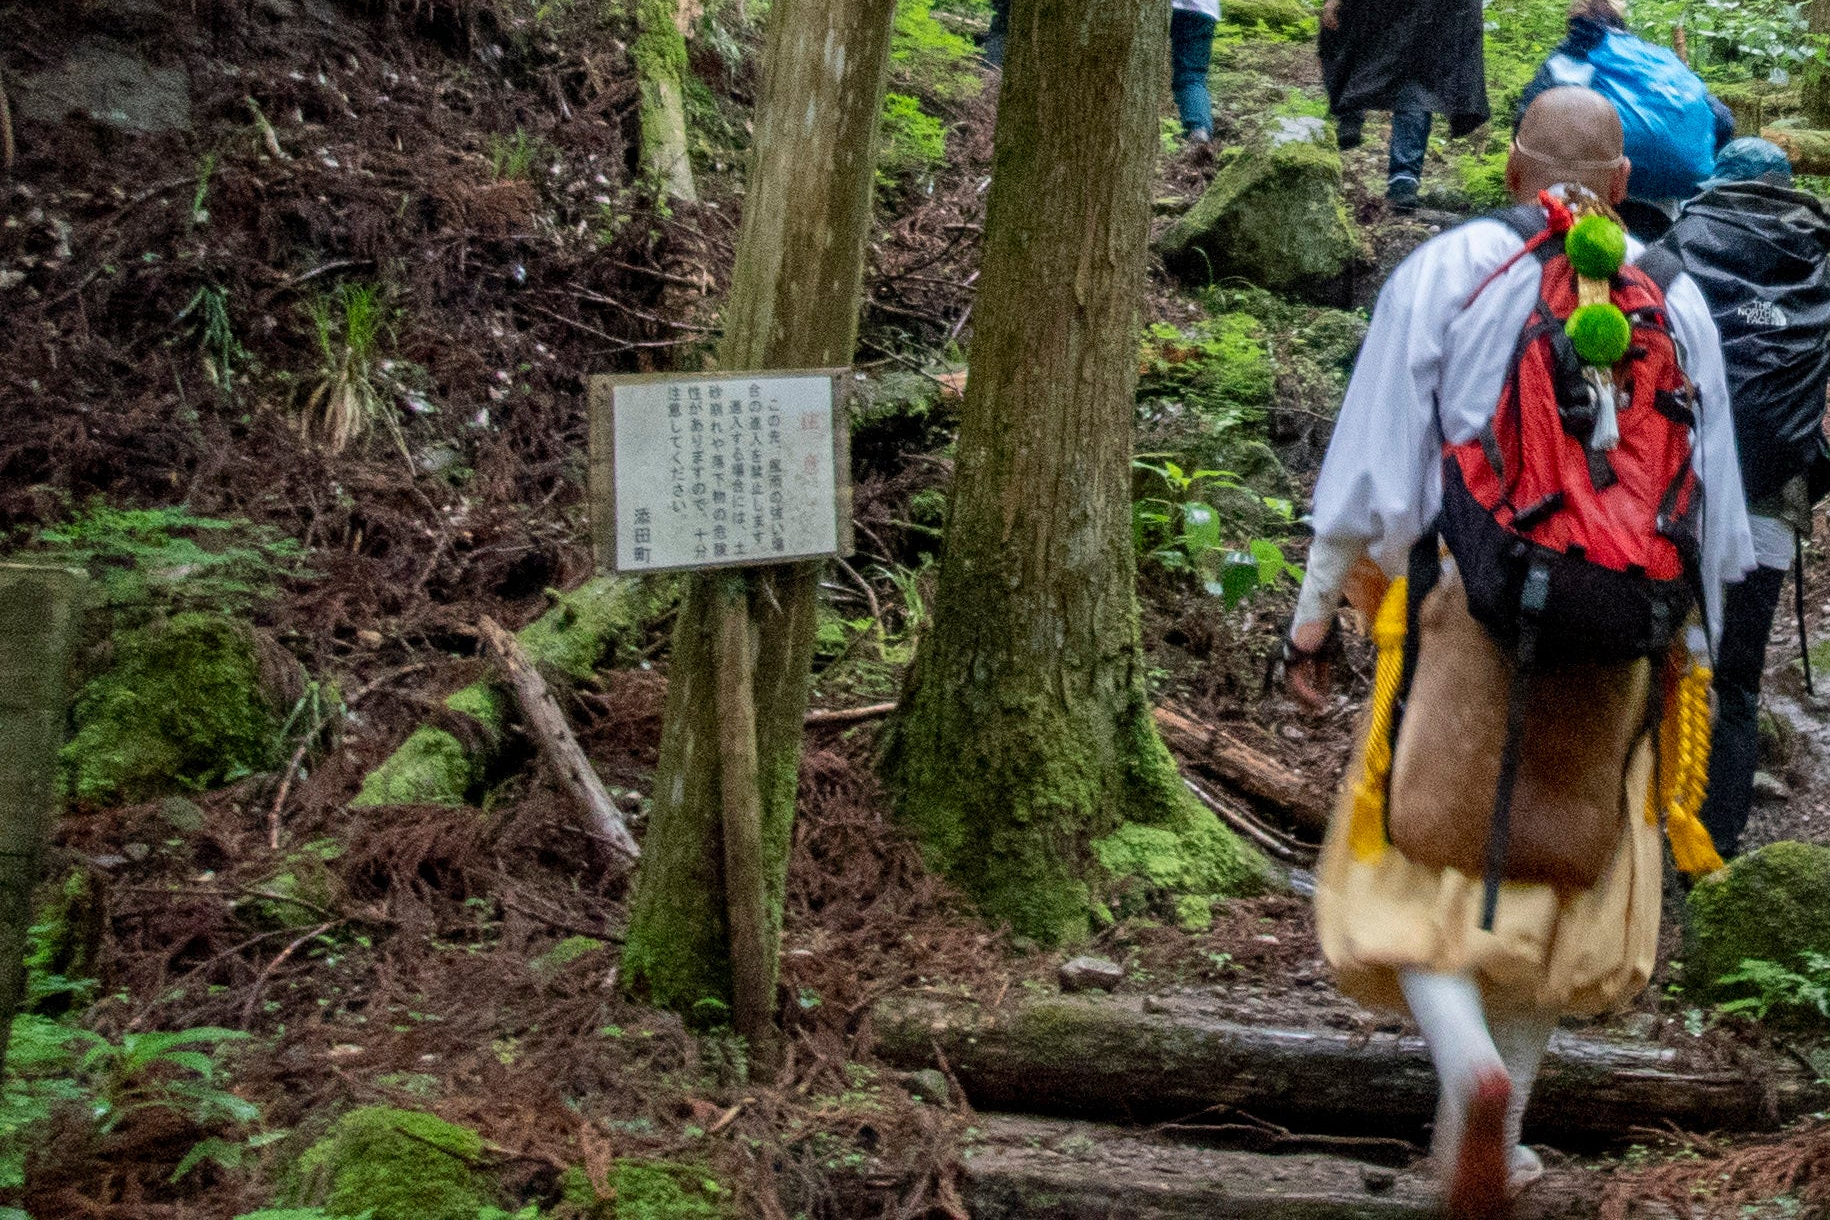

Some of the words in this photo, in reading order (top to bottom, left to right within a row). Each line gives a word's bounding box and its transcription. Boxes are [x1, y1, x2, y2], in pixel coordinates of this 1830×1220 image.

[1752, 299, 1772, 310] THE
[1737, 306, 1771, 318] NORTH
[1746, 314, 1770, 325] FACE
